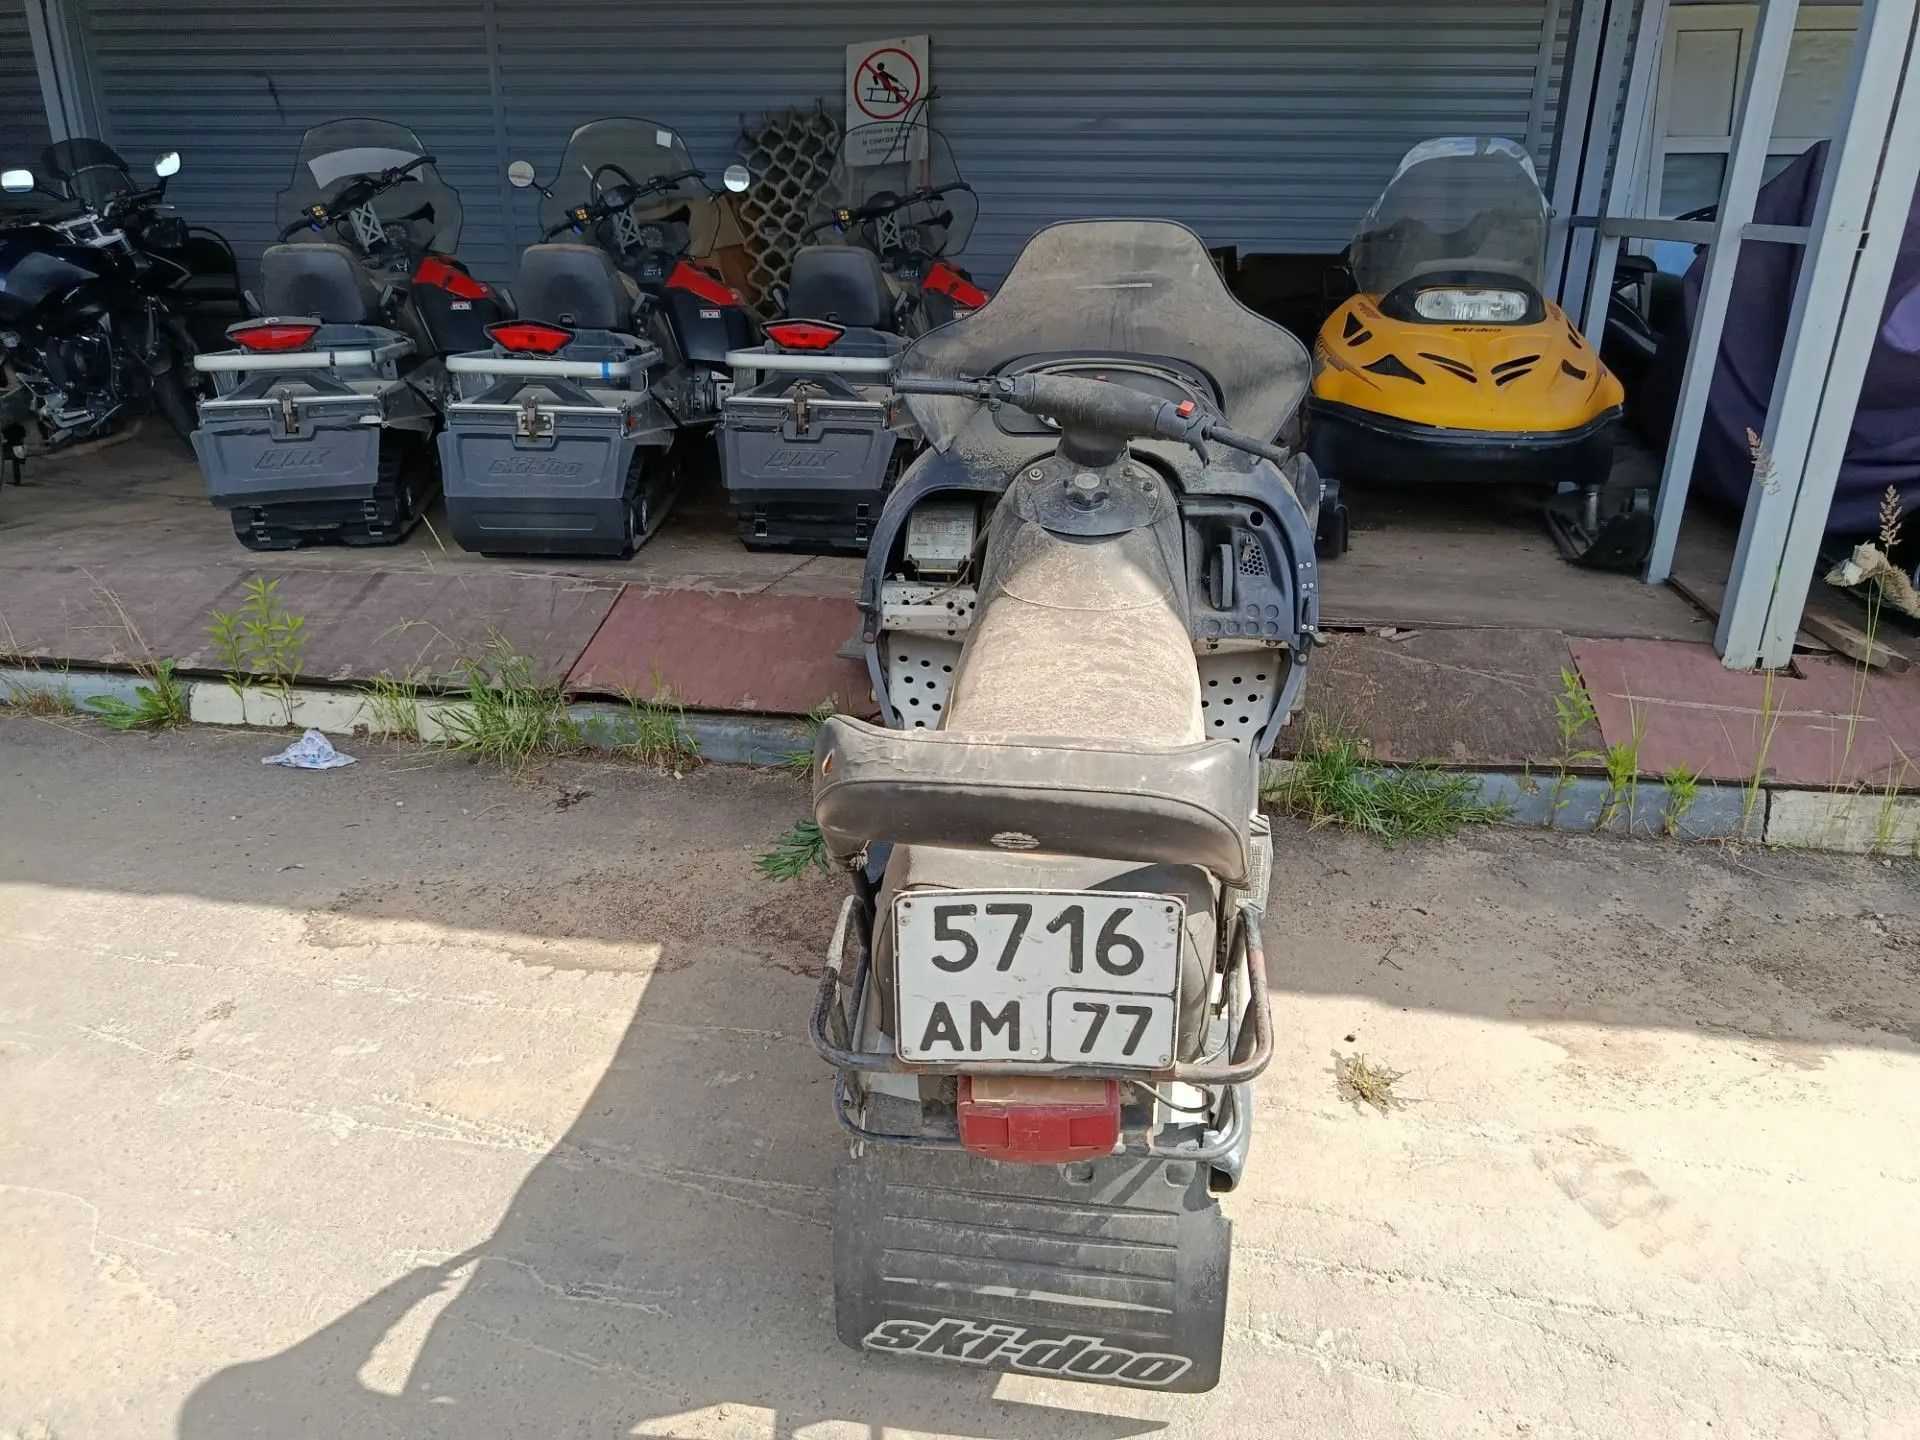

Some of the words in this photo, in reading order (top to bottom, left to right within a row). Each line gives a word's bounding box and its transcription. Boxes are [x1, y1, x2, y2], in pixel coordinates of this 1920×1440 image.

[931, 902, 1145, 976] 5716
[919, 1000, 1021, 1053] АМ
[1072, 1001, 1153, 1056] 77
[862, 1318, 1193, 1386] ski-doo
